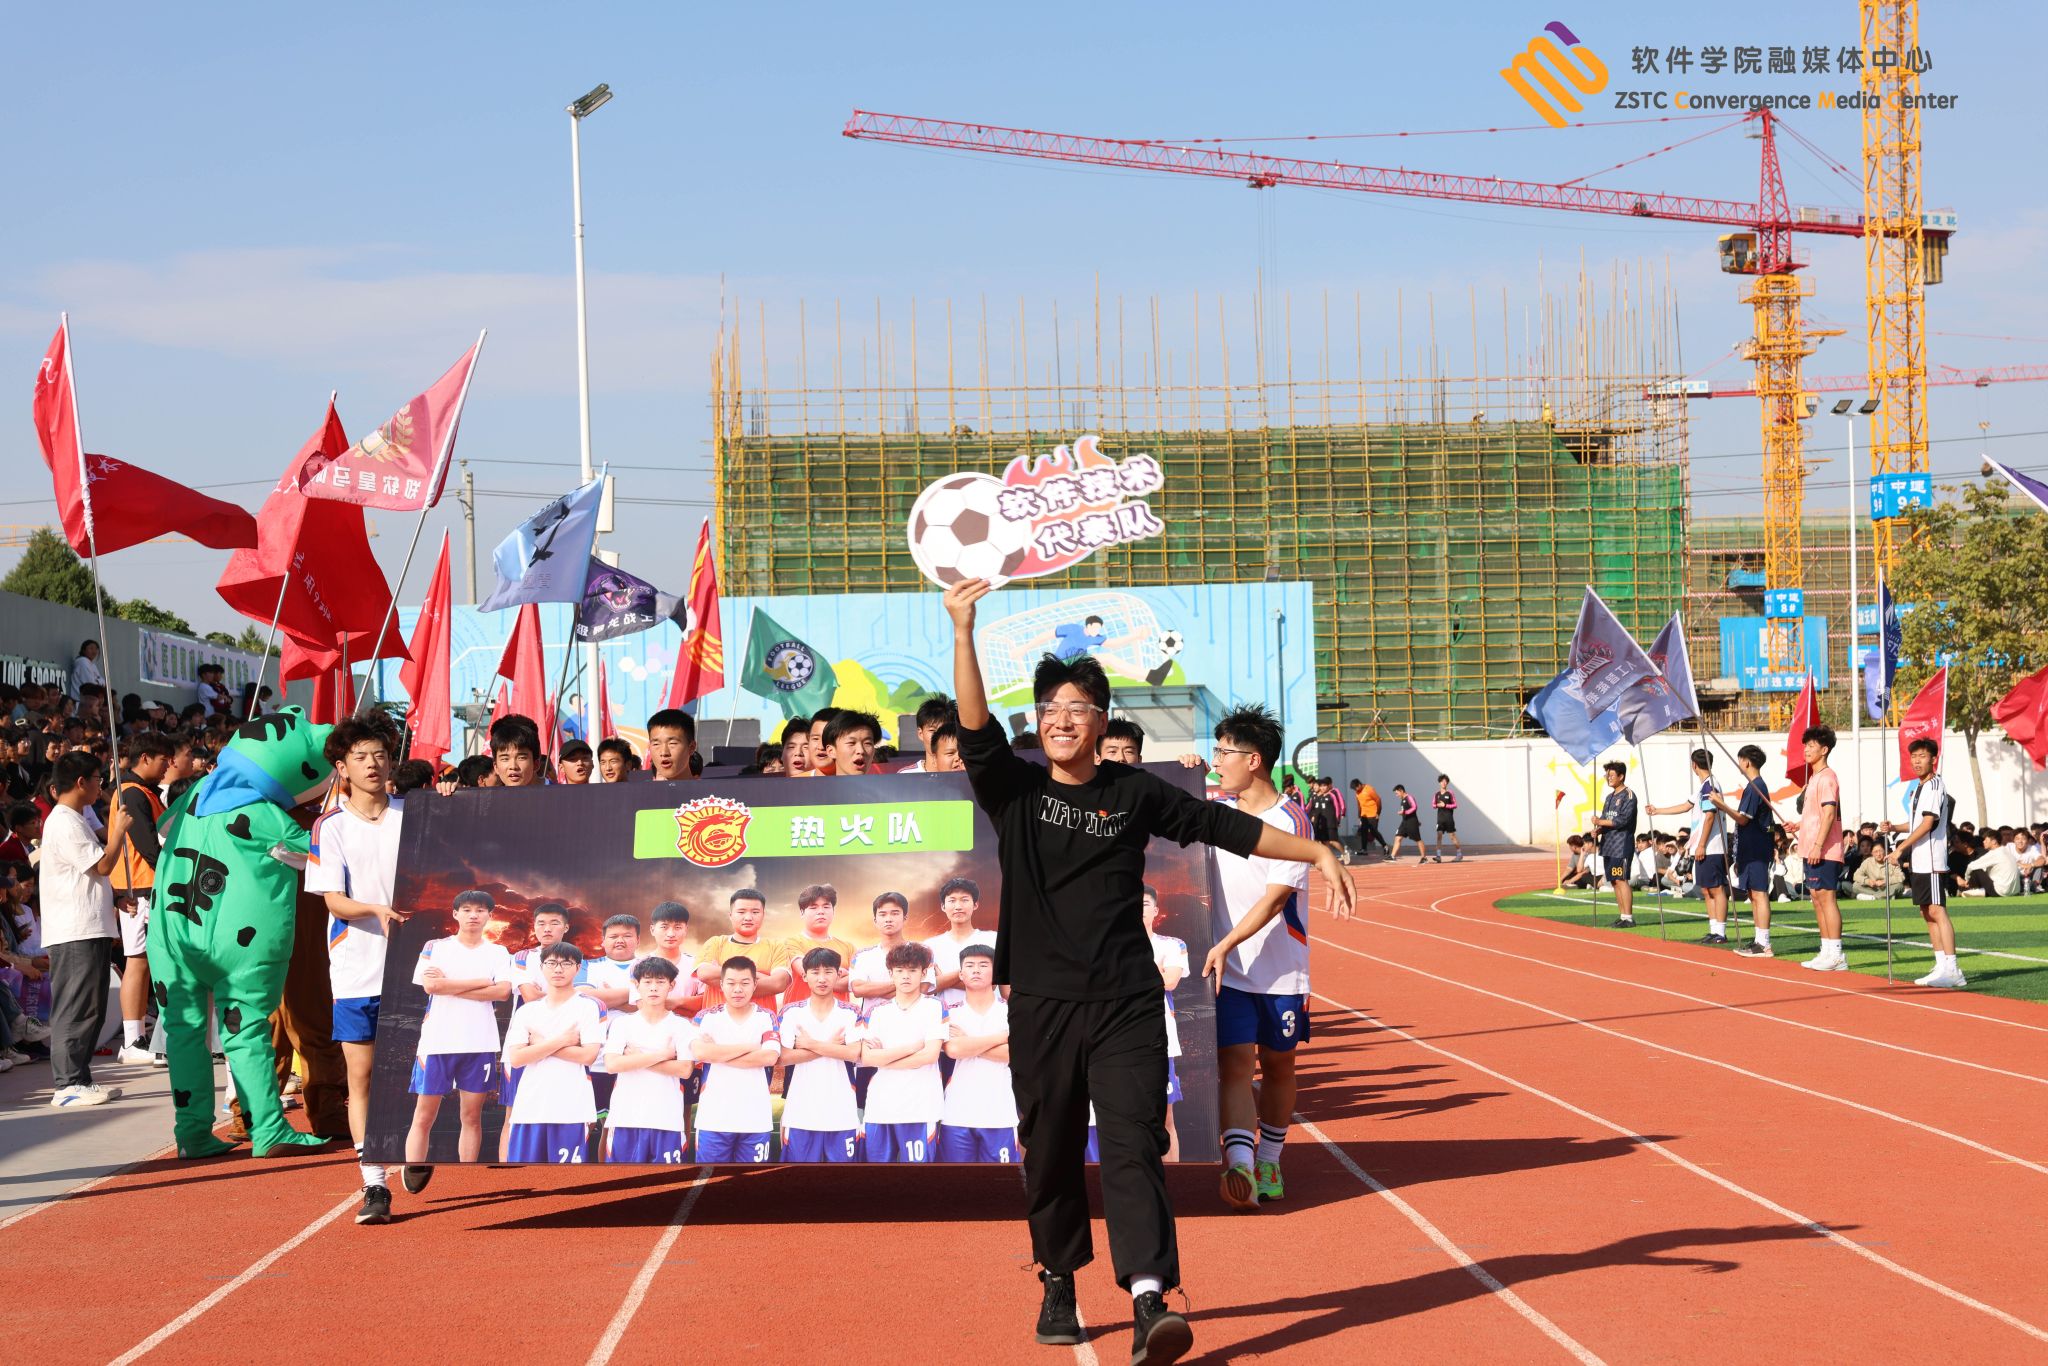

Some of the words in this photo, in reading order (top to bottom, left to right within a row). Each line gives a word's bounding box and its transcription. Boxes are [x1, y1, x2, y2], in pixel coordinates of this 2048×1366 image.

[997, 456, 1160, 523] 软件技术
[1034, 503, 1160, 560] 代表队
[768, 642, 805, 662] FOOTBALL
[776, 679, 808, 691] LEAGUE
[790, 811, 923, 848] 热火队
[1611, 866, 1623, 877] 88
[1282, 1010, 1296, 1038] 3
[483, 1062, 491, 1083] 7
[558, 1145, 582, 1164] 24
[845, 1136, 855, 1158] 5
[905, 1140, 924, 1162] 10
[999, 1147, 1009, 1164] 8
